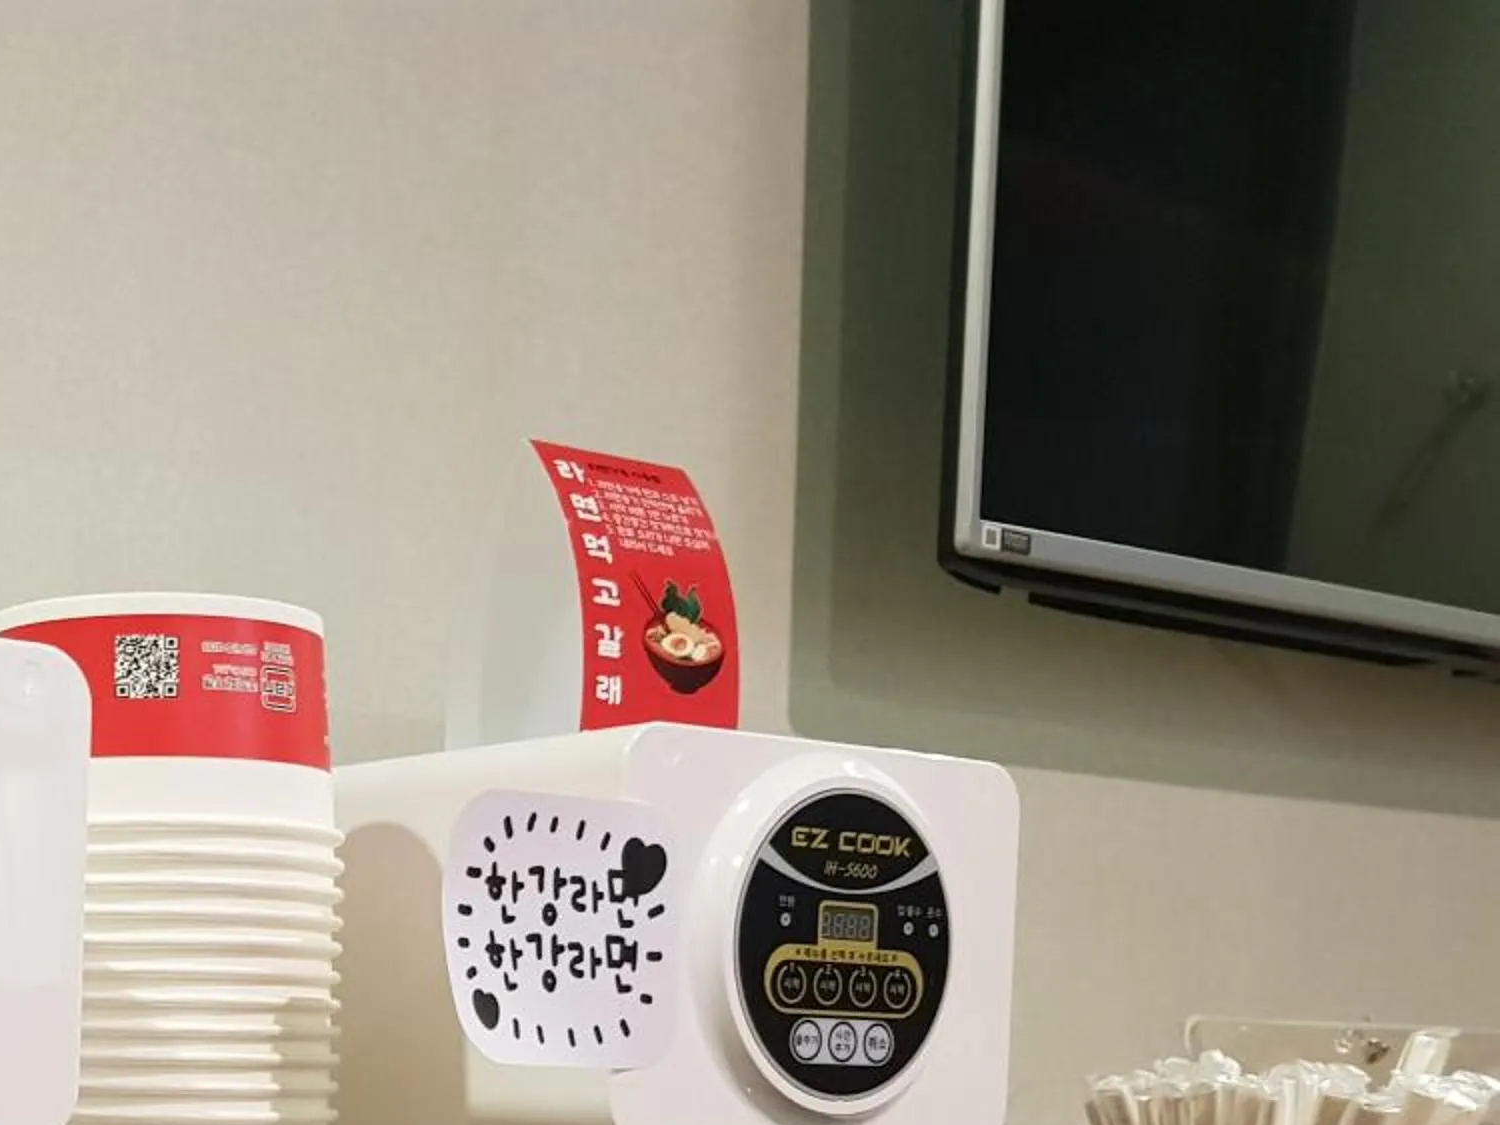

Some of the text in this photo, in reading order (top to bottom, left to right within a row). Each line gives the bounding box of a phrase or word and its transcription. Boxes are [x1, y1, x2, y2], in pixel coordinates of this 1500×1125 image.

[791, 826, 912, 857] EZ COOK
[824, 860, 878, 879] IH-5600
[484, 930, 639, 994] 한강라면
